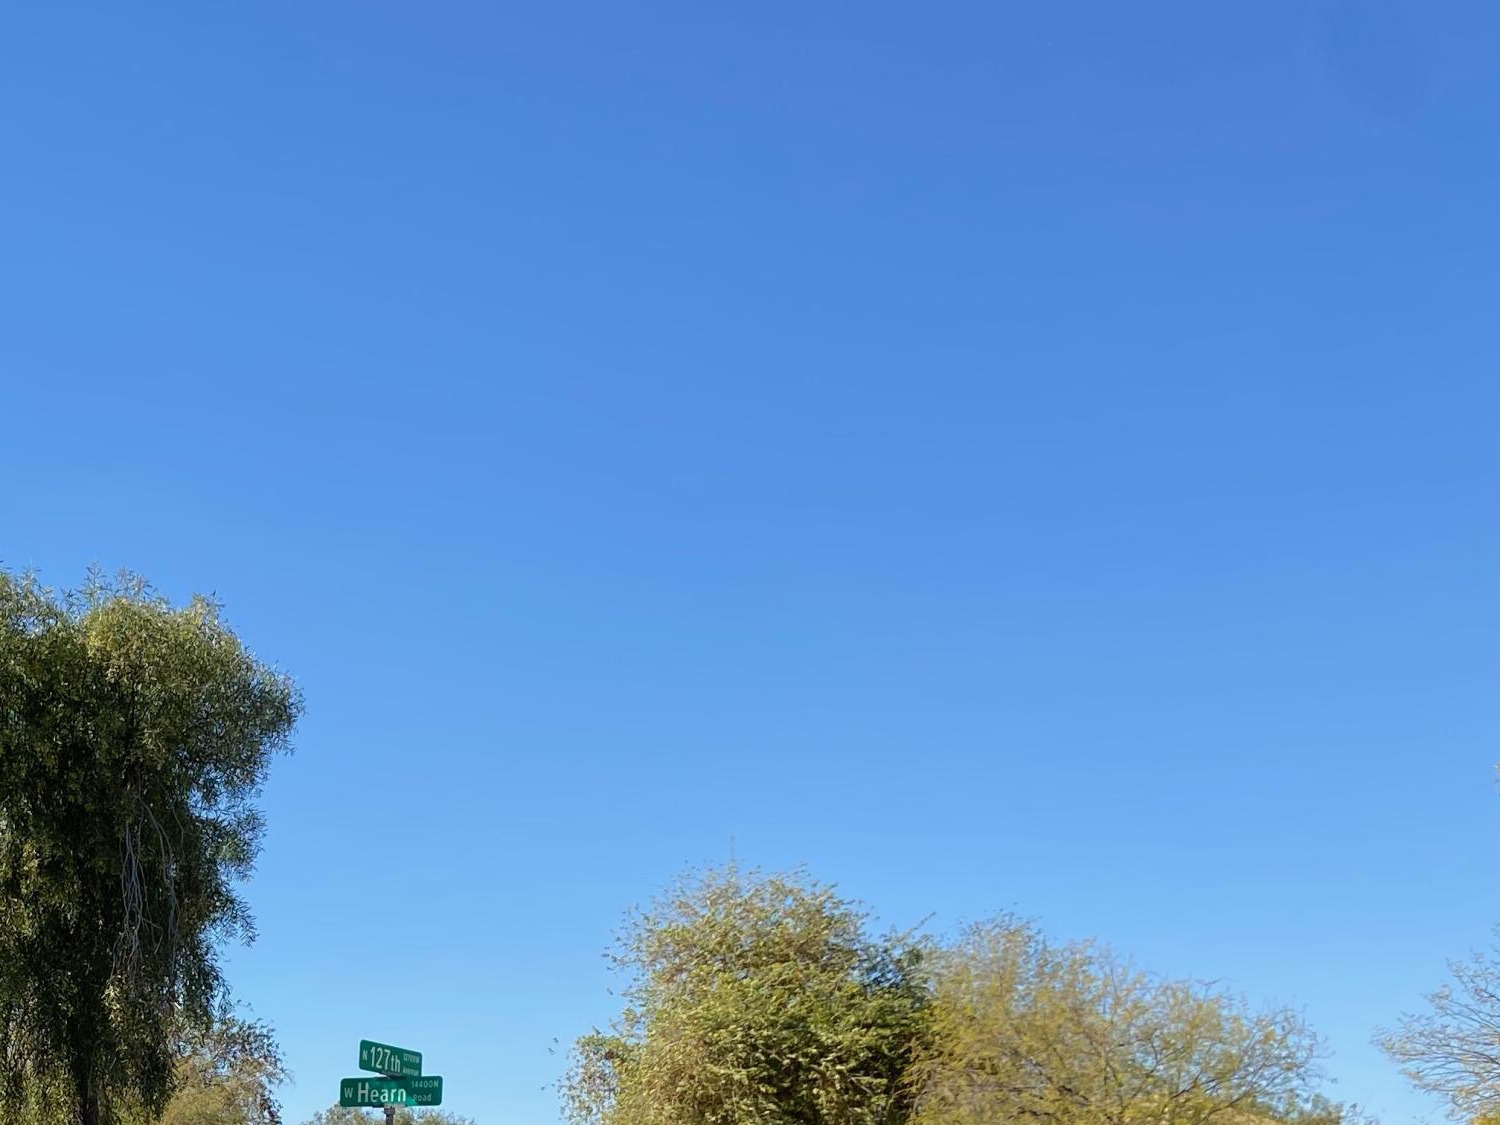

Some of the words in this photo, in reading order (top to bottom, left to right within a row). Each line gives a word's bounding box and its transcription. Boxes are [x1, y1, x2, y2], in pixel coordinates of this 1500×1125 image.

[362, 1049, 368, 1061] N
[370, 1046, 401, 1073] 127th
[411, 1079, 439, 1088] 14400N
[344, 1087, 353, 1098] W
[357, 1082, 406, 1103] Hearn
[412, 1093, 432, 1102] Road
